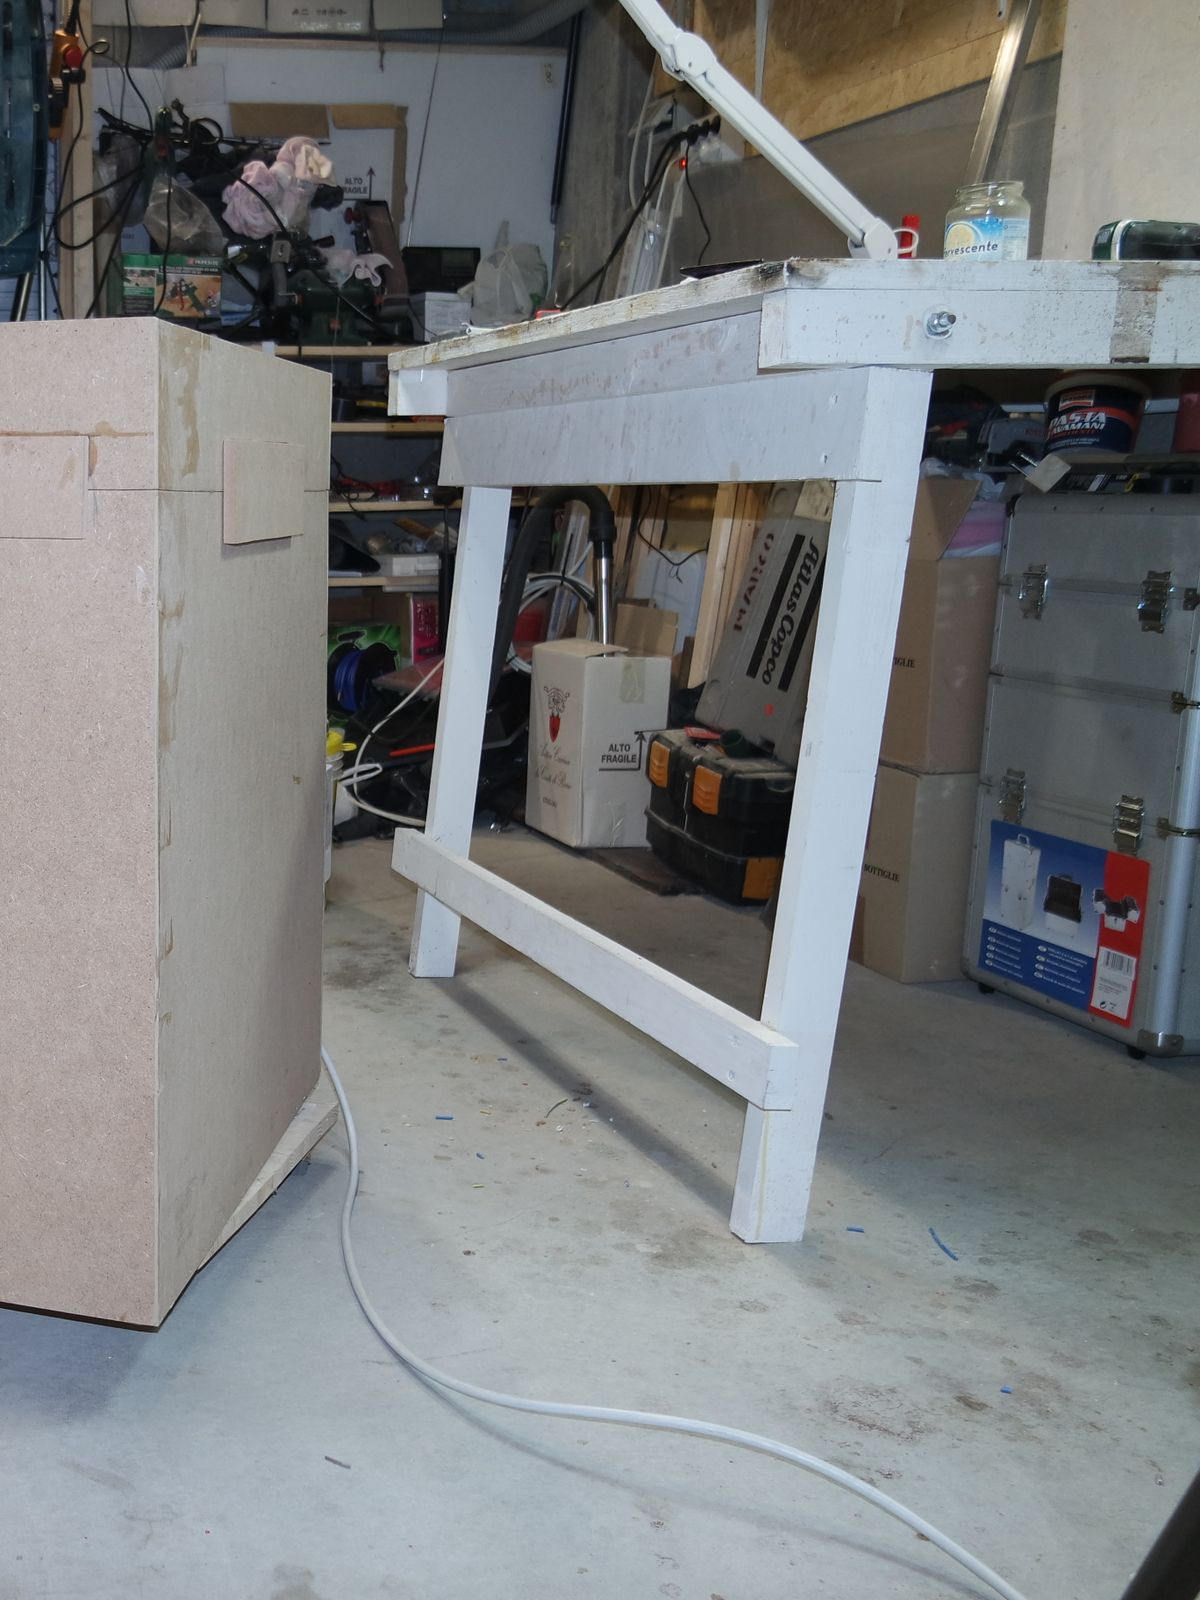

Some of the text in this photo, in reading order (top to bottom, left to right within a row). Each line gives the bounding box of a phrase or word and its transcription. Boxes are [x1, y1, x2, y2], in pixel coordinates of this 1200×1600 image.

[344, 177, 364, 185] ALTO
[342, 186, 368, 194] RAGILE
[944, 240, 998, 257] ervescente
[1049, 411, 1106, 429] PASTA
[761, 537, 820, 685] Atlas Copco
[893, 656, 916, 669] IGLIE
[608, 743, 631, 753] ALTO
[601, 754, 637, 764] FRAGILE
[863, 863, 900, 883] BOTTIGLIE
